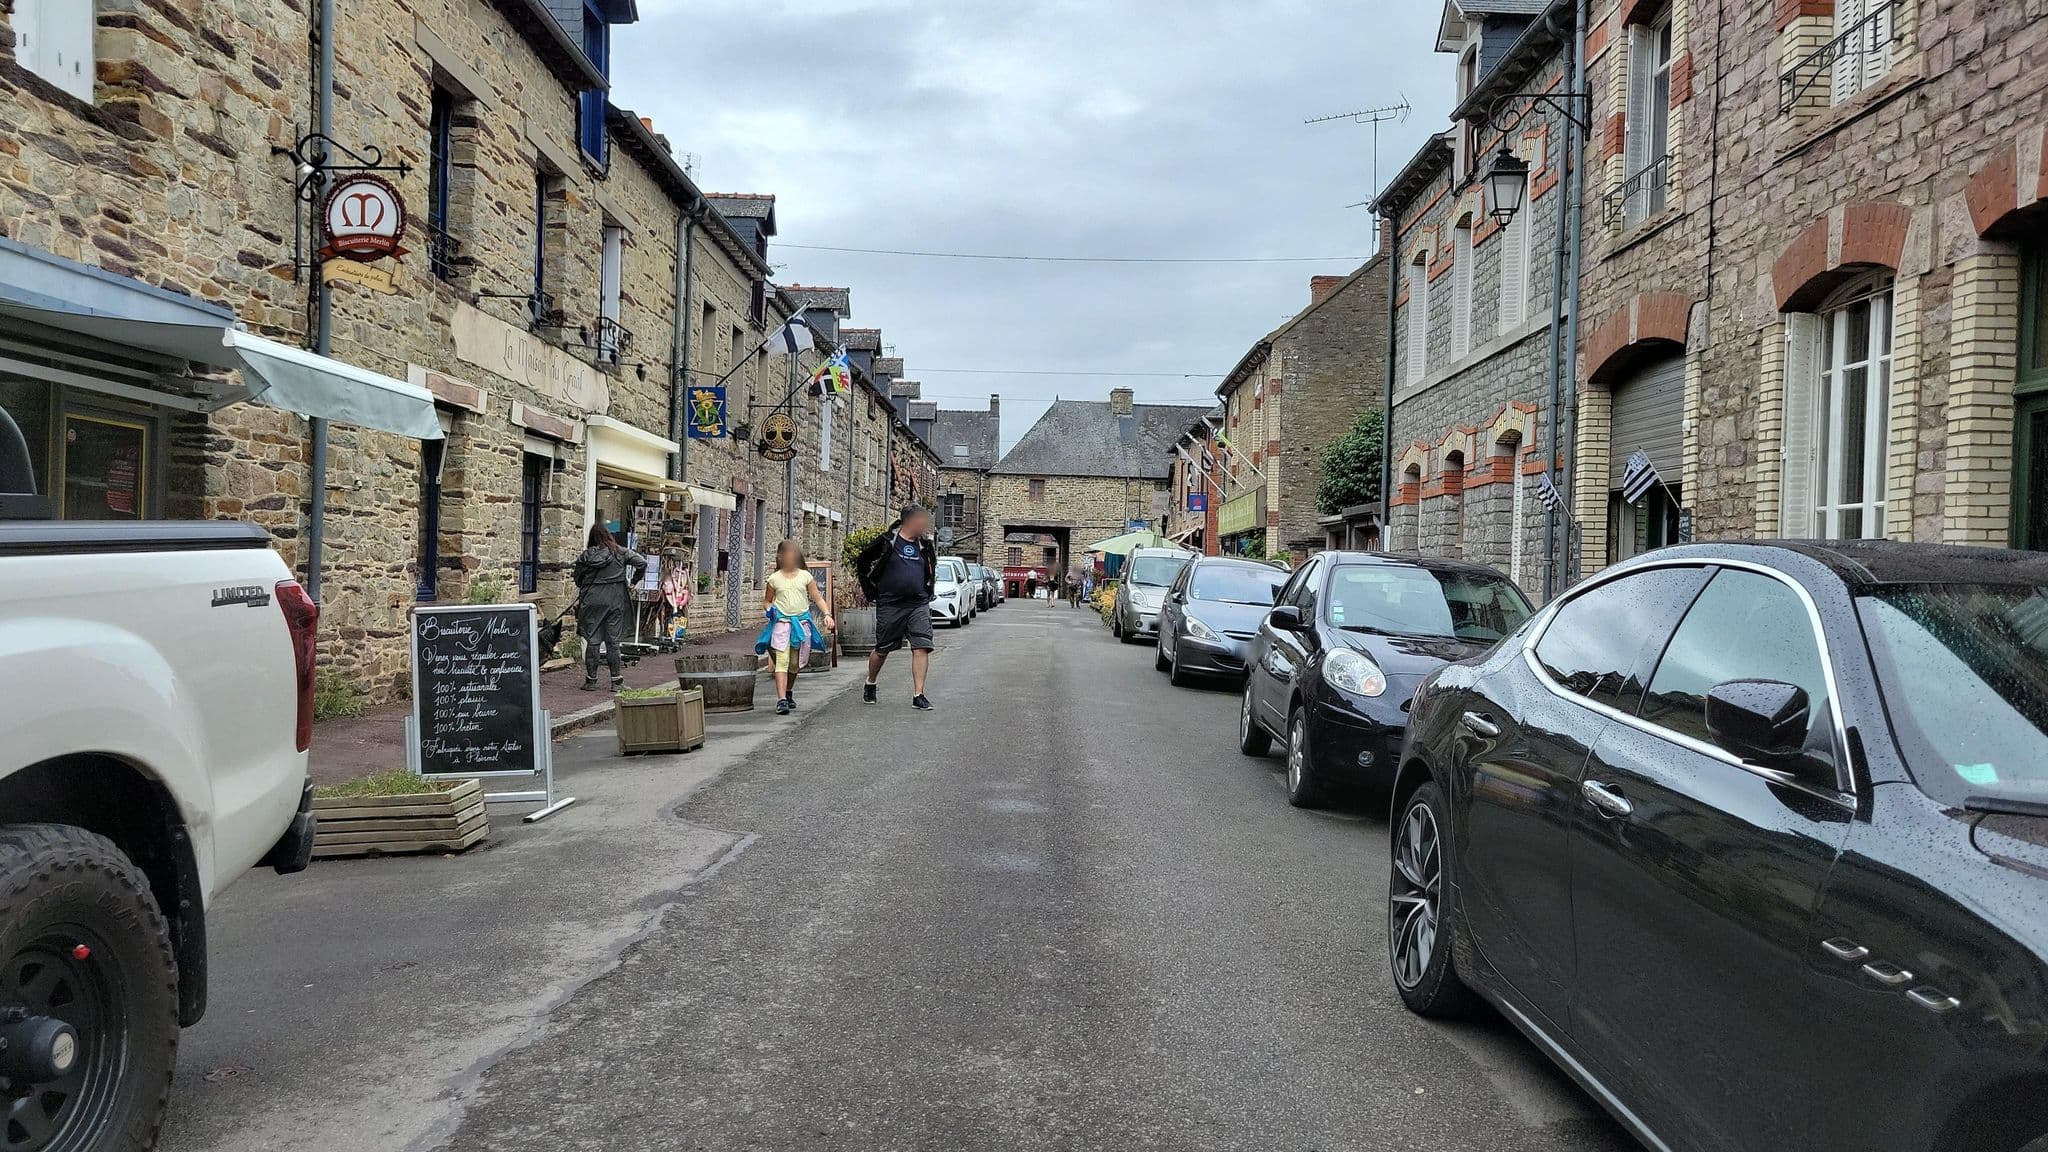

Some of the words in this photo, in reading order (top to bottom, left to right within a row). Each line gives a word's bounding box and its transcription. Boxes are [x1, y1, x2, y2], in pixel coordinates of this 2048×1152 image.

[341, 192, 385, 231] M
[338, 236, 369, 247] Biscuiterie
[370, 237, 390, 247] Merlin
[517, 336, 547, 387] Maison
[551, 353, 560, 380] du
[213, 585, 265, 601] LIMITED
[419, 616, 481, 645] Biscuiterie
[482, 616, 520, 639] Merlin
[422, 645, 450, 669] Venez
[452, 653, 468, 661] vous
[500, 651, 520, 661] avec
[480, 664, 488, 675] &
[433, 681, 456, 694] 100%
[434, 694, 456, 706] 100%
[457, 694, 488, 708] plaisir
[433, 707, 455, 720] 100%
[455, 712, 470, 724] pur
[472, 704, 499, 718] beurre
[433, 721, 454, 734] 100%
[456, 719, 484, 732] breton
[482, 741, 500, 751] notre
